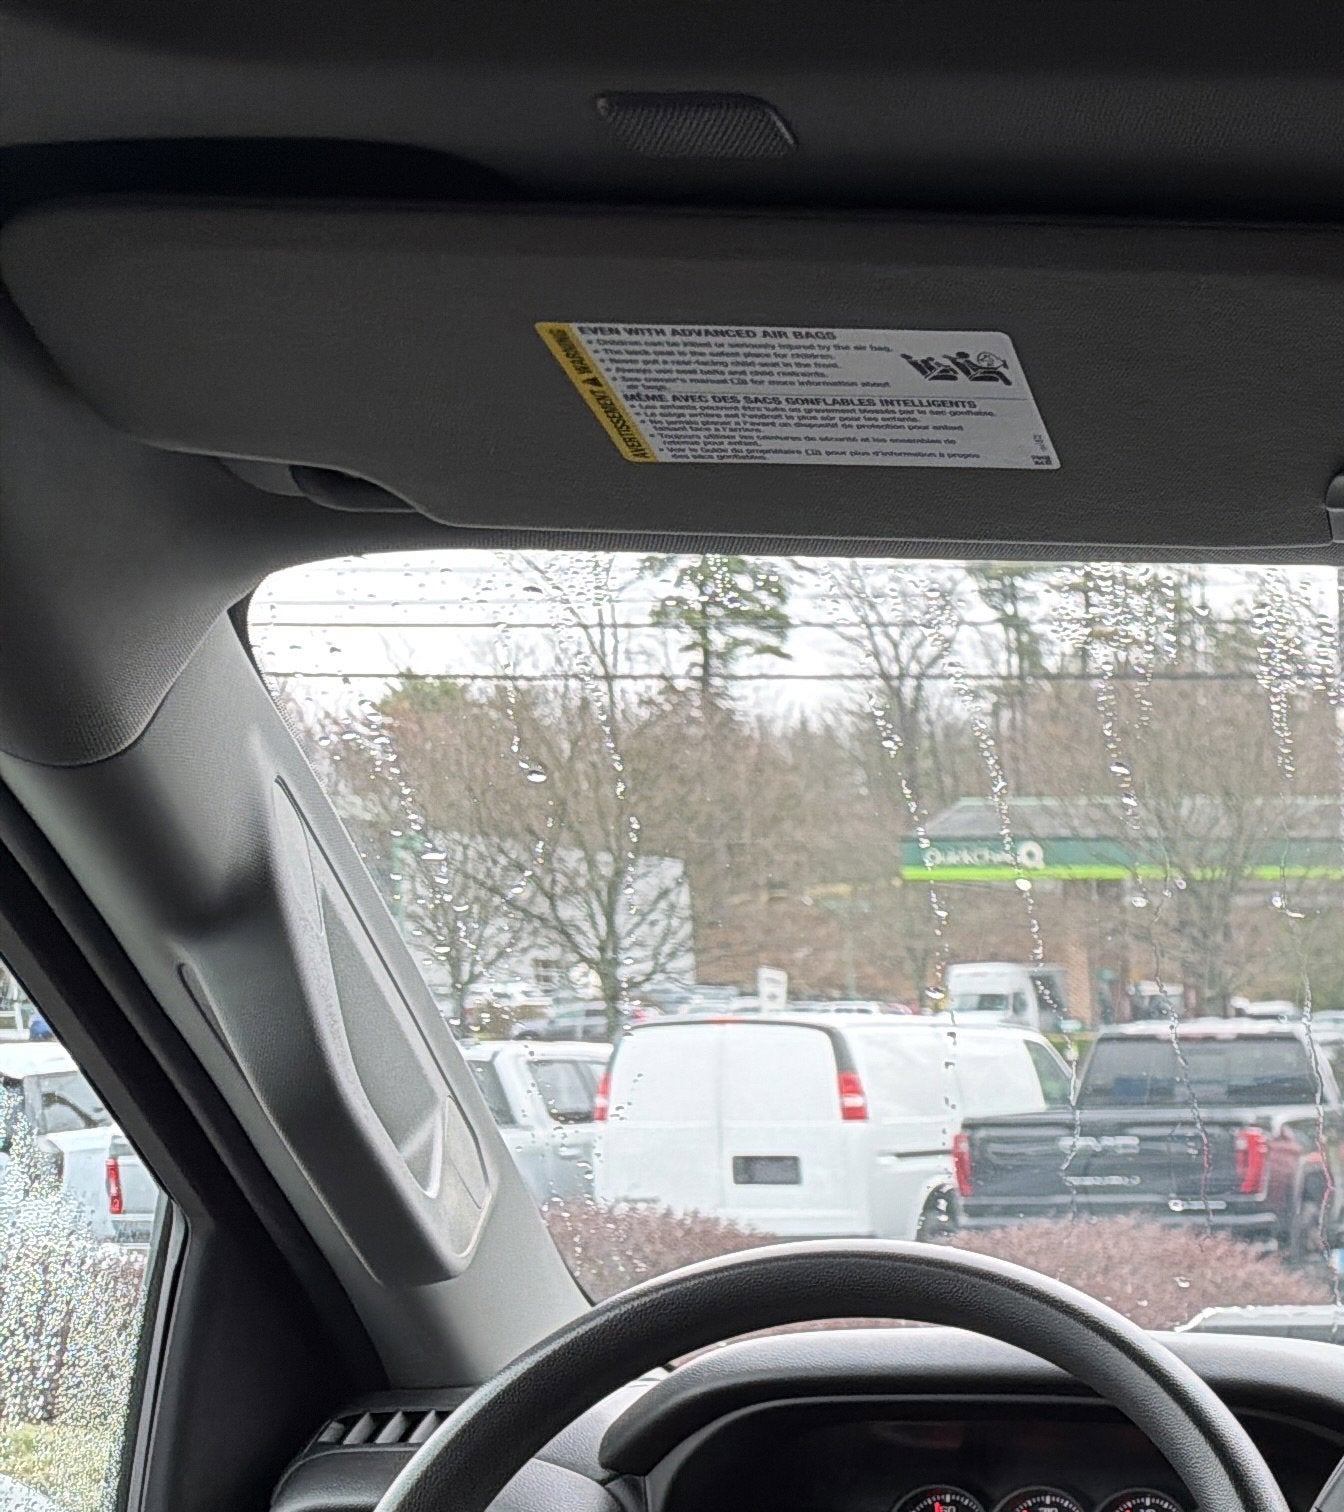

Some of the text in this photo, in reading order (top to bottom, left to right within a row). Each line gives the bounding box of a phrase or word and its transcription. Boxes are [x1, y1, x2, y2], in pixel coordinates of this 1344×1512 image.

[577, 325, 836, 340] EVEN WITH ADVANCED AIR BAGS
[670, 394, 708, 403] AVEC
[710, 394, 740, 404] DES
[742, 395, 781, 404] SACS
[784, 396, 876, 406] GONFLABLES
[879, 398, 976, 408] INTELLIGENTS
